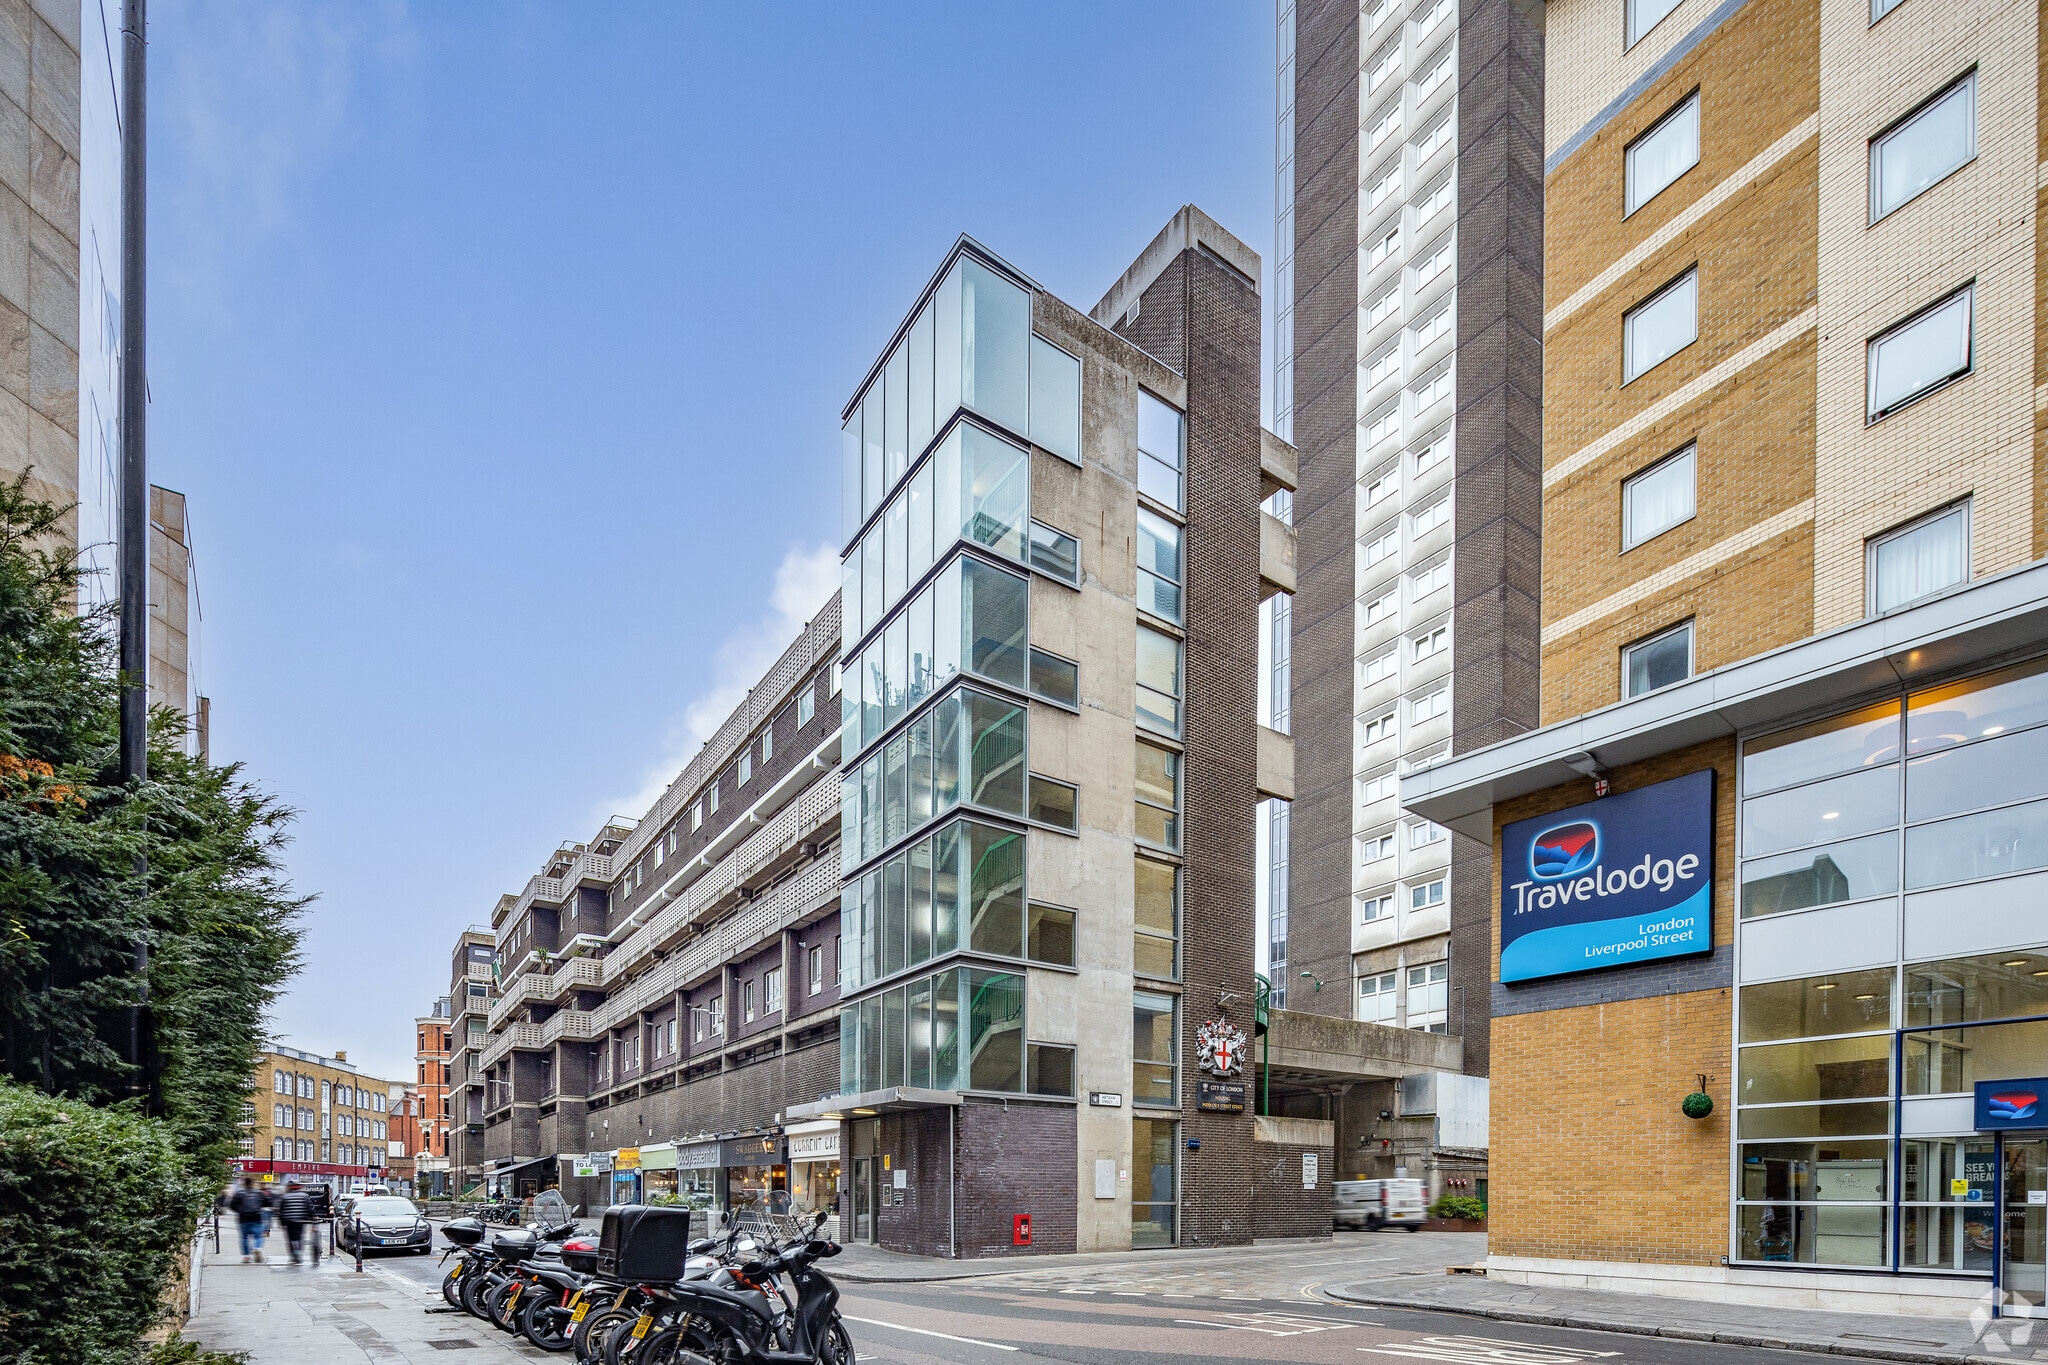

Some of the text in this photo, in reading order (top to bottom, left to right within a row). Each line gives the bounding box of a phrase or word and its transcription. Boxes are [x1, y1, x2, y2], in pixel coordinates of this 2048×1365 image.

[1510, 853, 1700, 914] Travelodge
[1639, 917, 1695, 936] London
[1585, 929, 1694, 958] Liverpool Street
[793, 1138, 822, 1153] CURRENT
[292, 1163, 321, 1171] EMPIRE
[1965, 1162, 1985, 1173] SEE
